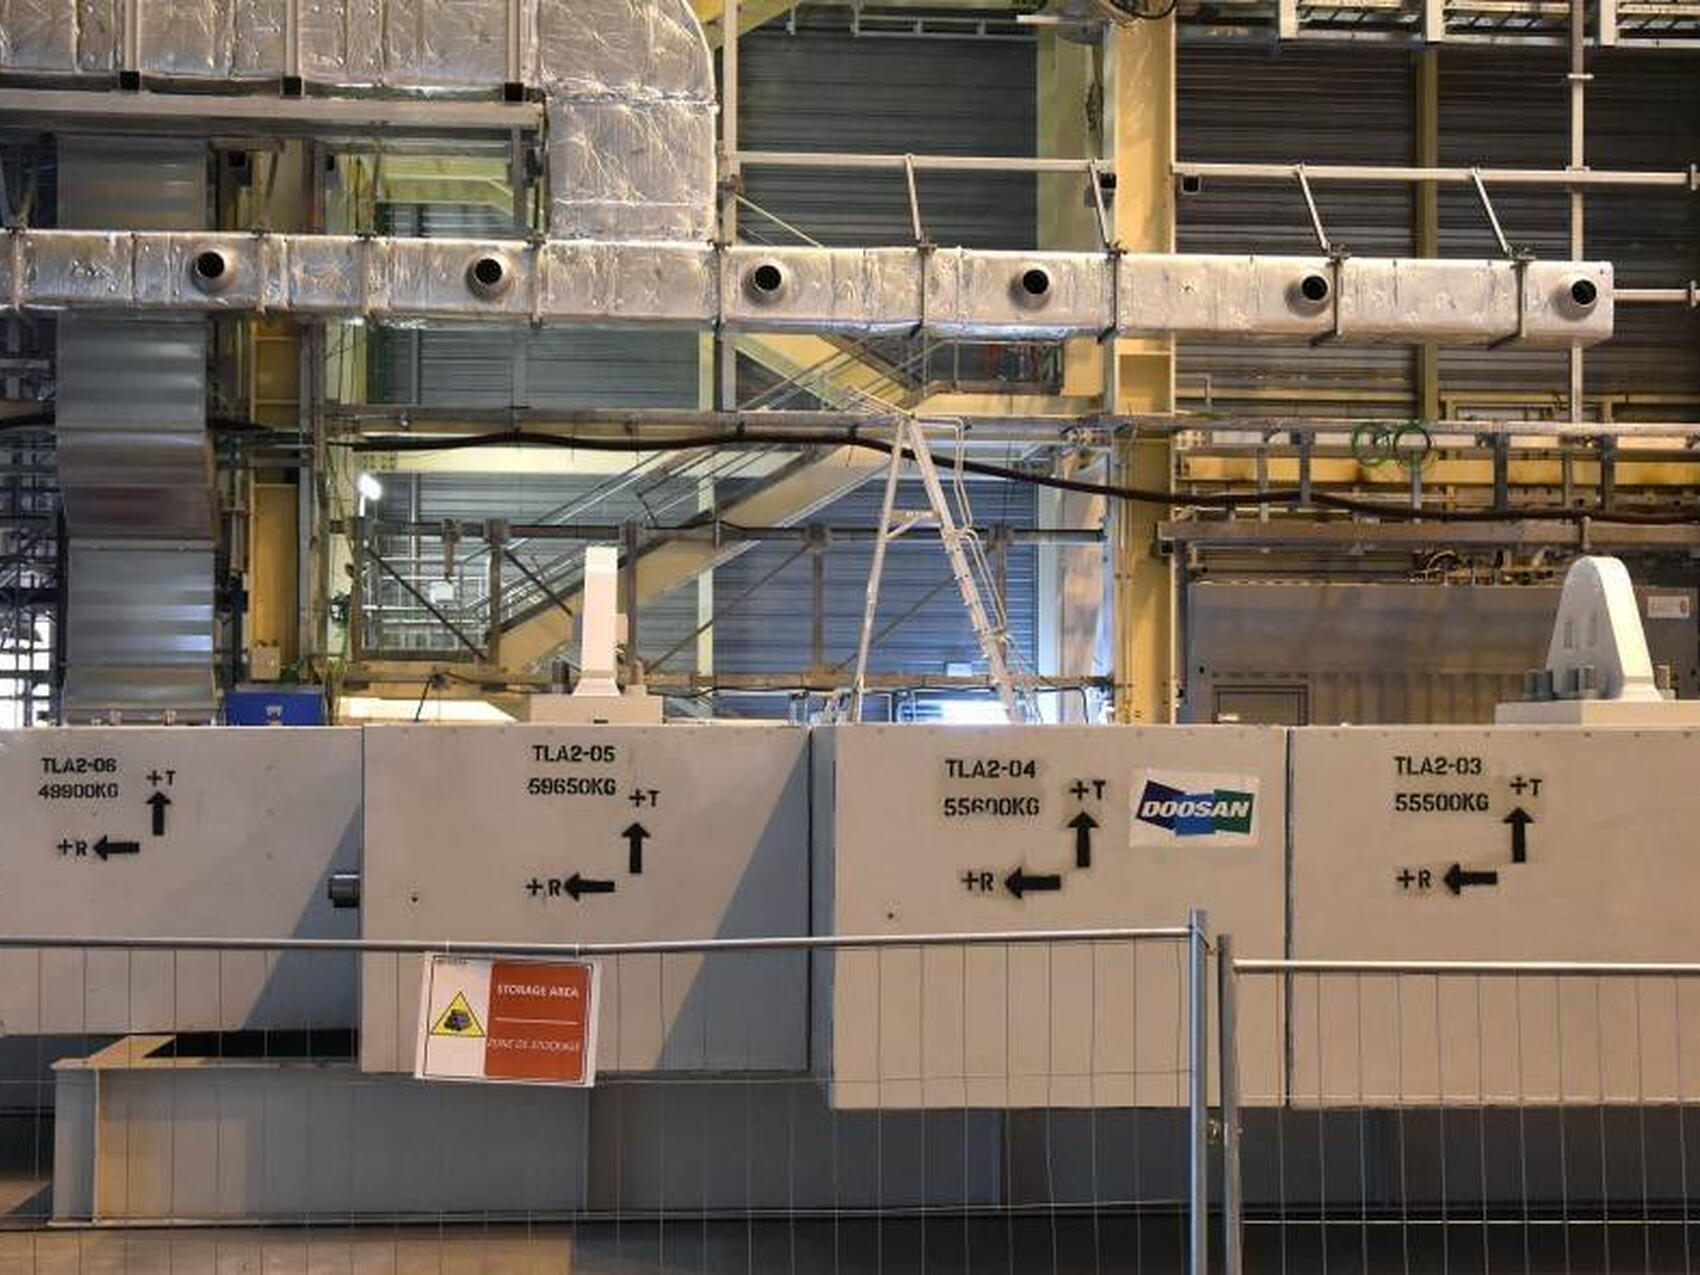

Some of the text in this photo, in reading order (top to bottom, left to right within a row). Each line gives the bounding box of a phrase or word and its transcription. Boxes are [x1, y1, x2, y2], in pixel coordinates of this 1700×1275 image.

[533, 745, 616, 762] TLA2-05
[42, 757, 117, 773] TLA2-06
[945, 759, 1036, 778] TLA2-04
[1394, 756, 1483, 775] TLA2-03
[38, 783, 119, 799] 49900KG
[944, 797, 1040, 817] 55600KG
[1141, 801, 1249, 818] DOOSAN
[1395, 793, 1490, 812] 55500KG
[497, 984, 579, 998] STORAGE AREA
